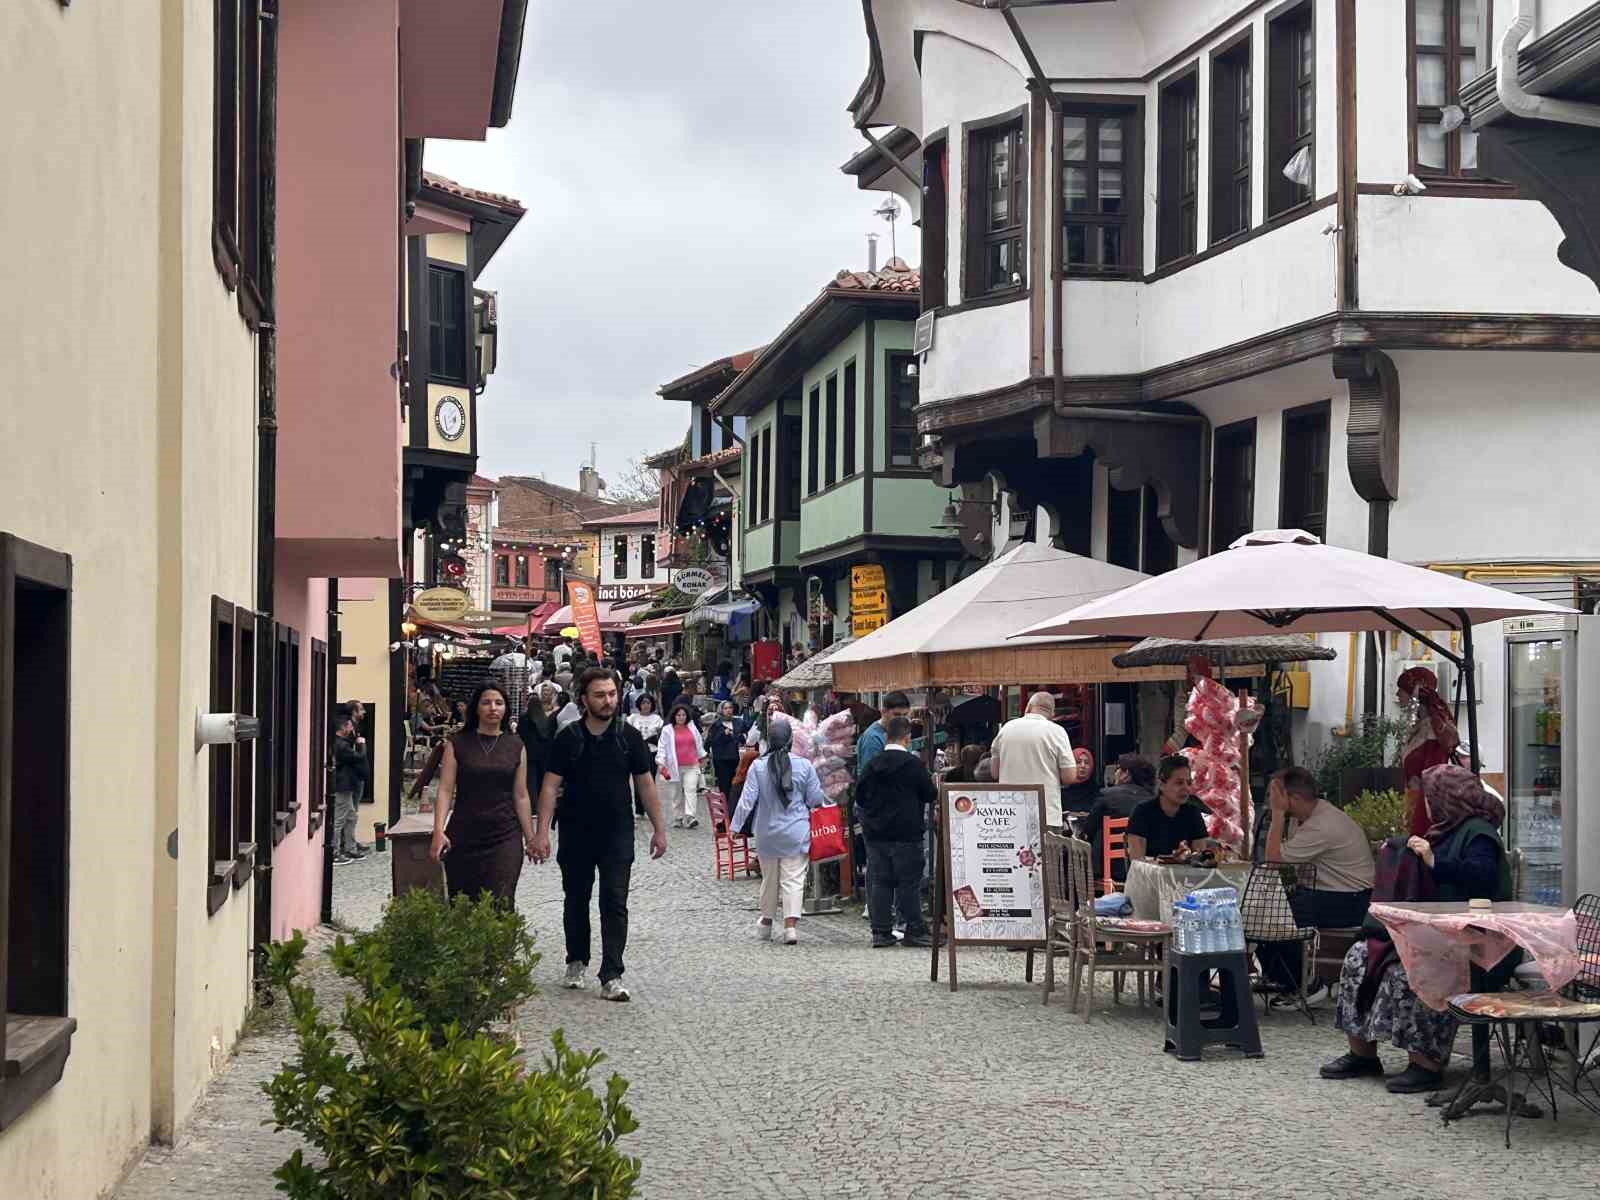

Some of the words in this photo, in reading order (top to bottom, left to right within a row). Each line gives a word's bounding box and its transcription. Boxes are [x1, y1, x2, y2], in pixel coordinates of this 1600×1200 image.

[598, 586, 618, 600] inci
[977, 807, 1016, 817] KAYMAK
[984, 818, 1010, 826] CAFE
